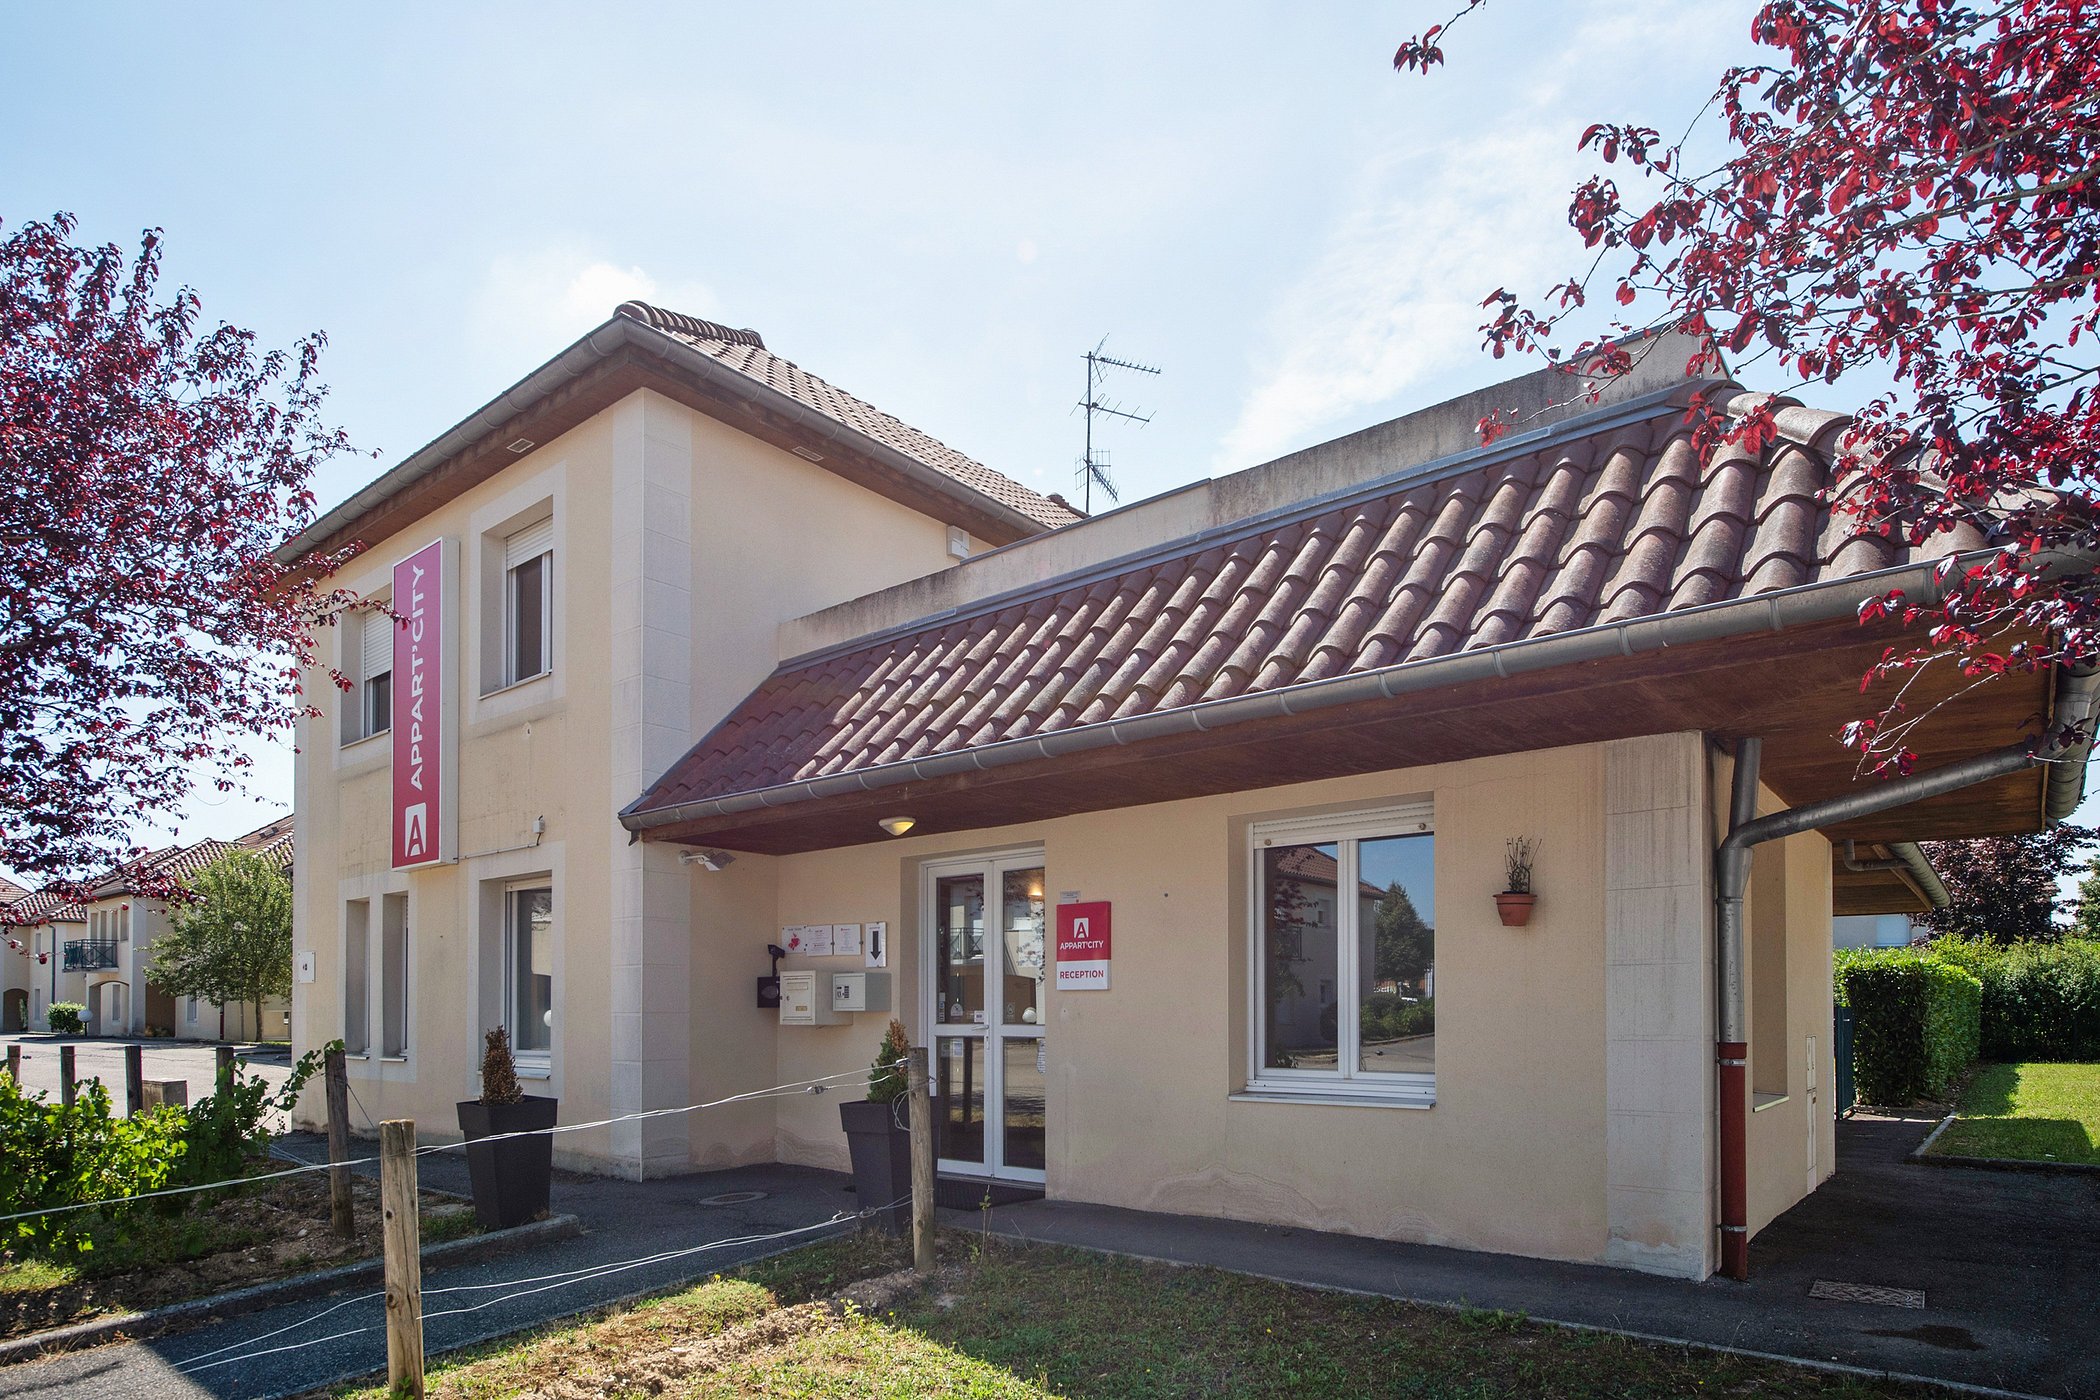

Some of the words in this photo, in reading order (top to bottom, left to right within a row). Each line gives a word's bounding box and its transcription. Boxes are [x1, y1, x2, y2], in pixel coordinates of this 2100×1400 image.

[411, 564, 424, 791] APPART'CITY
[1060, 941, 1104, 950] APPART'CITY
[1060, 970, 1104, 979] RECEPTION
